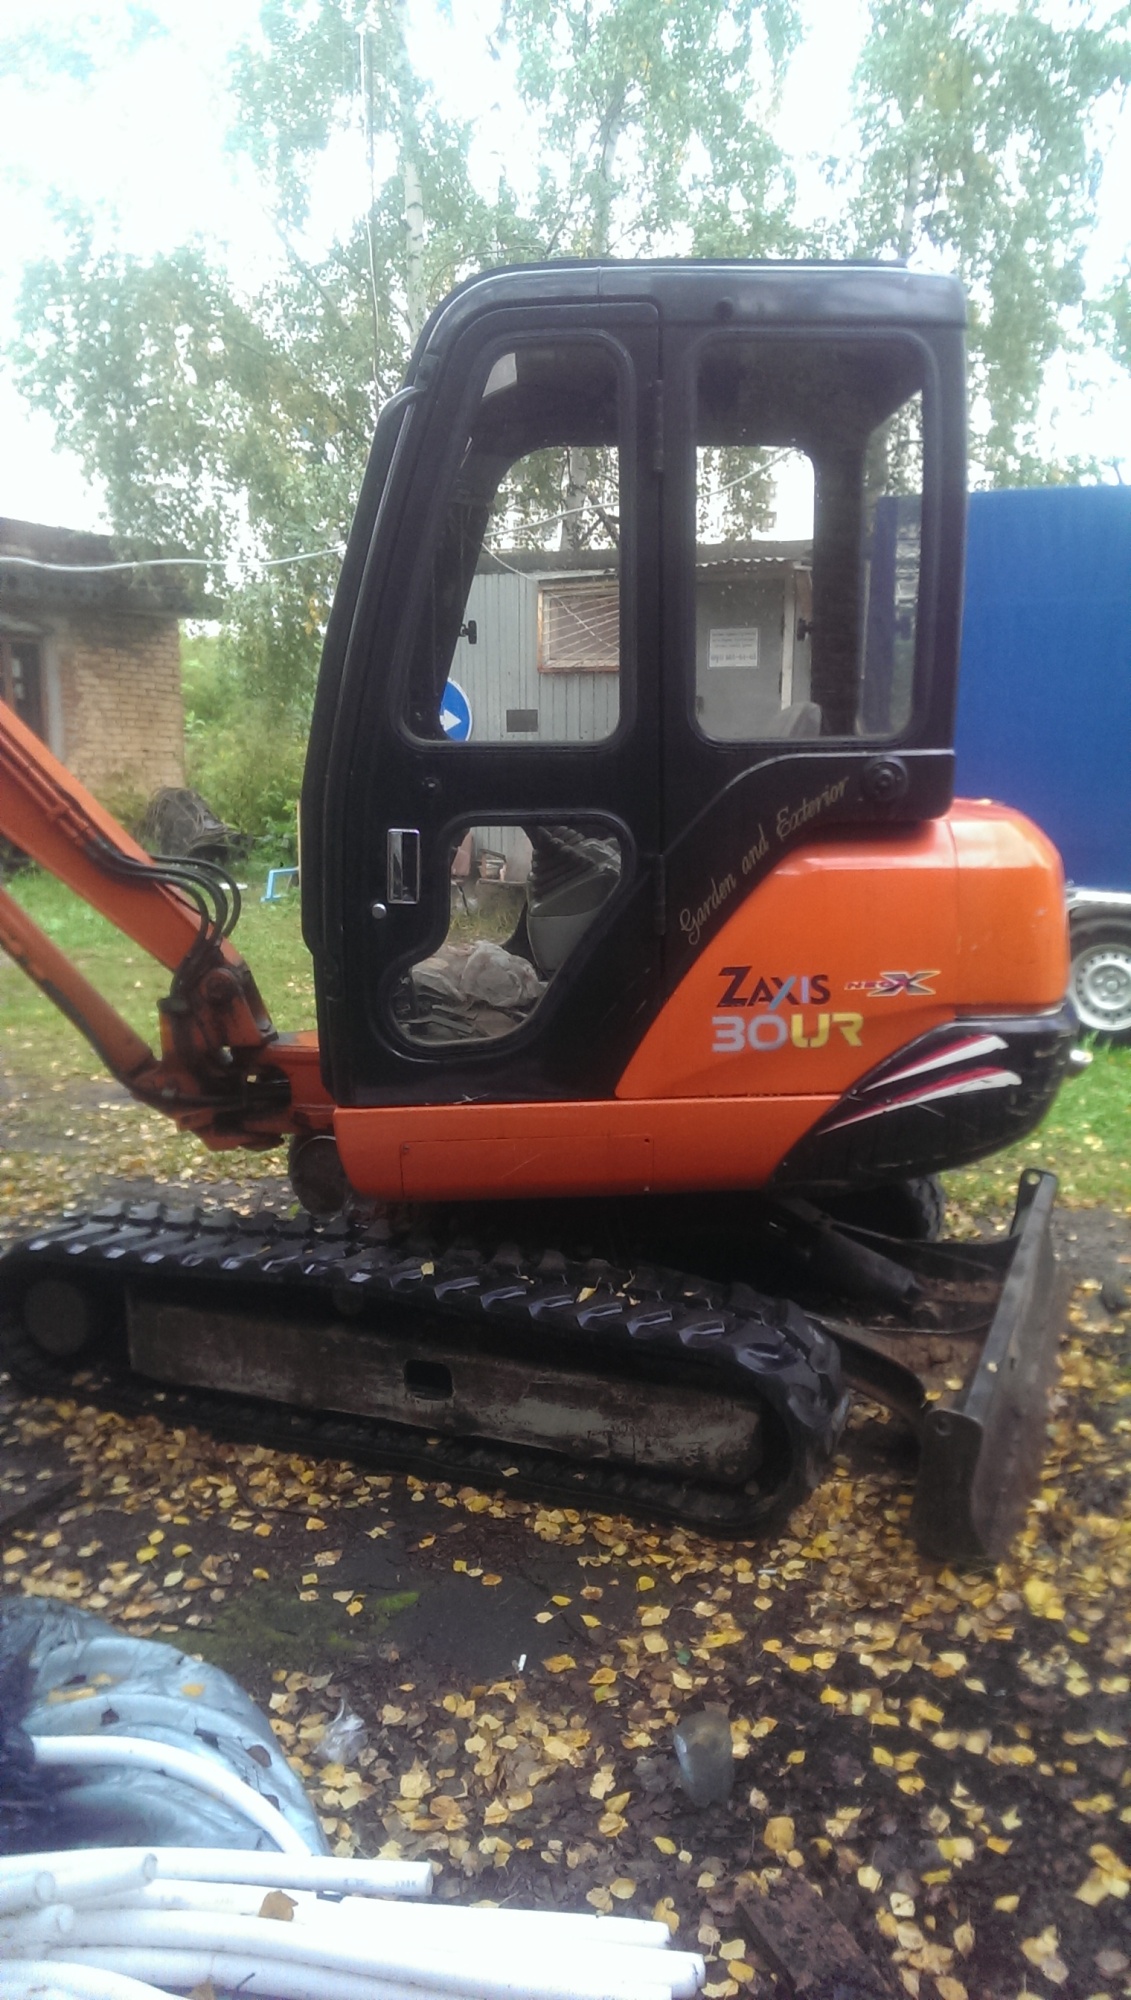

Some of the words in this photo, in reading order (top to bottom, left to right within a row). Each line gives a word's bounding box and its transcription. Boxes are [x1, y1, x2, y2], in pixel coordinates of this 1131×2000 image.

[679, 873, 737, 945] Garden
[741, 823, 769, 875] and
[776, 777, 849, 841] Exterior
[711, 1012, 864, 1052] 30UR
